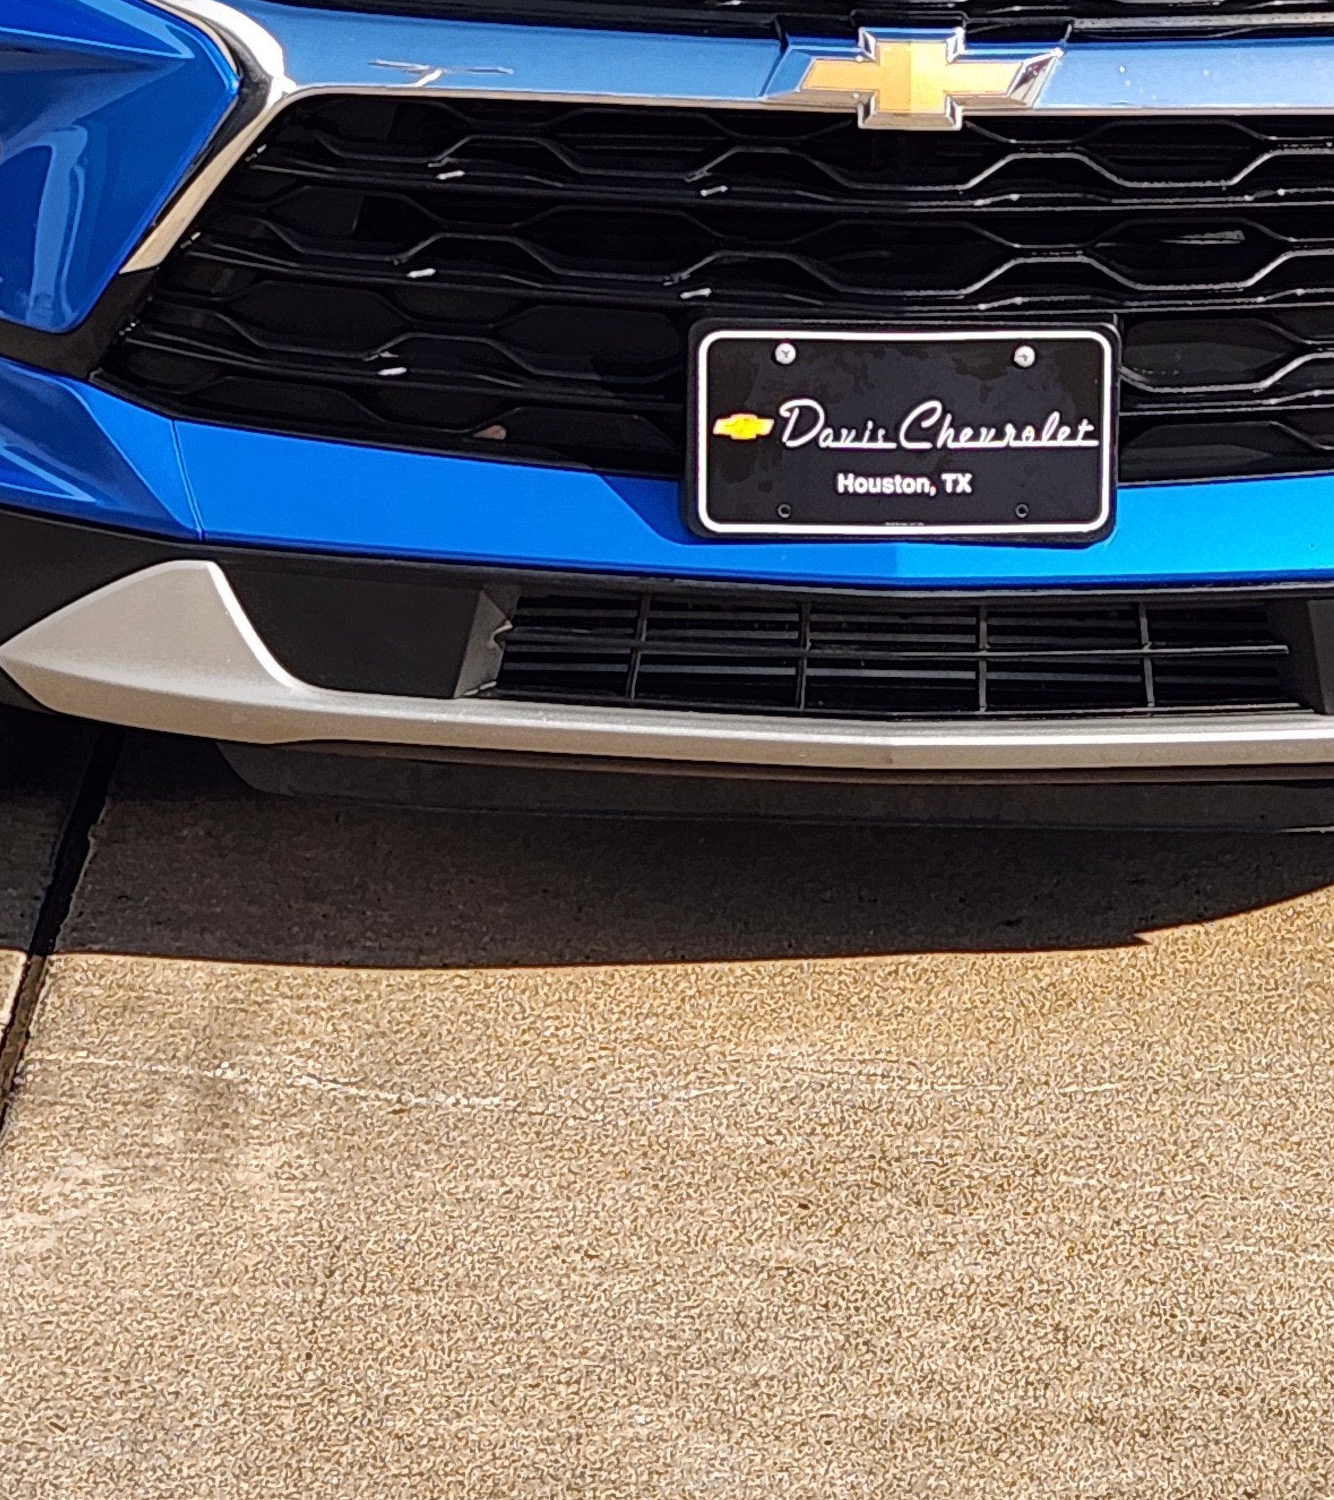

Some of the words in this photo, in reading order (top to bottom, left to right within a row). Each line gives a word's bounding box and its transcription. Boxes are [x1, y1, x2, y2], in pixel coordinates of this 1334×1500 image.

[779, 398, 897, 449] Davis
[899, 400, 1099, 449] Chevrolet
[836, 472, 937, 497] Houston,
[941, 472, 973, 494] TX
